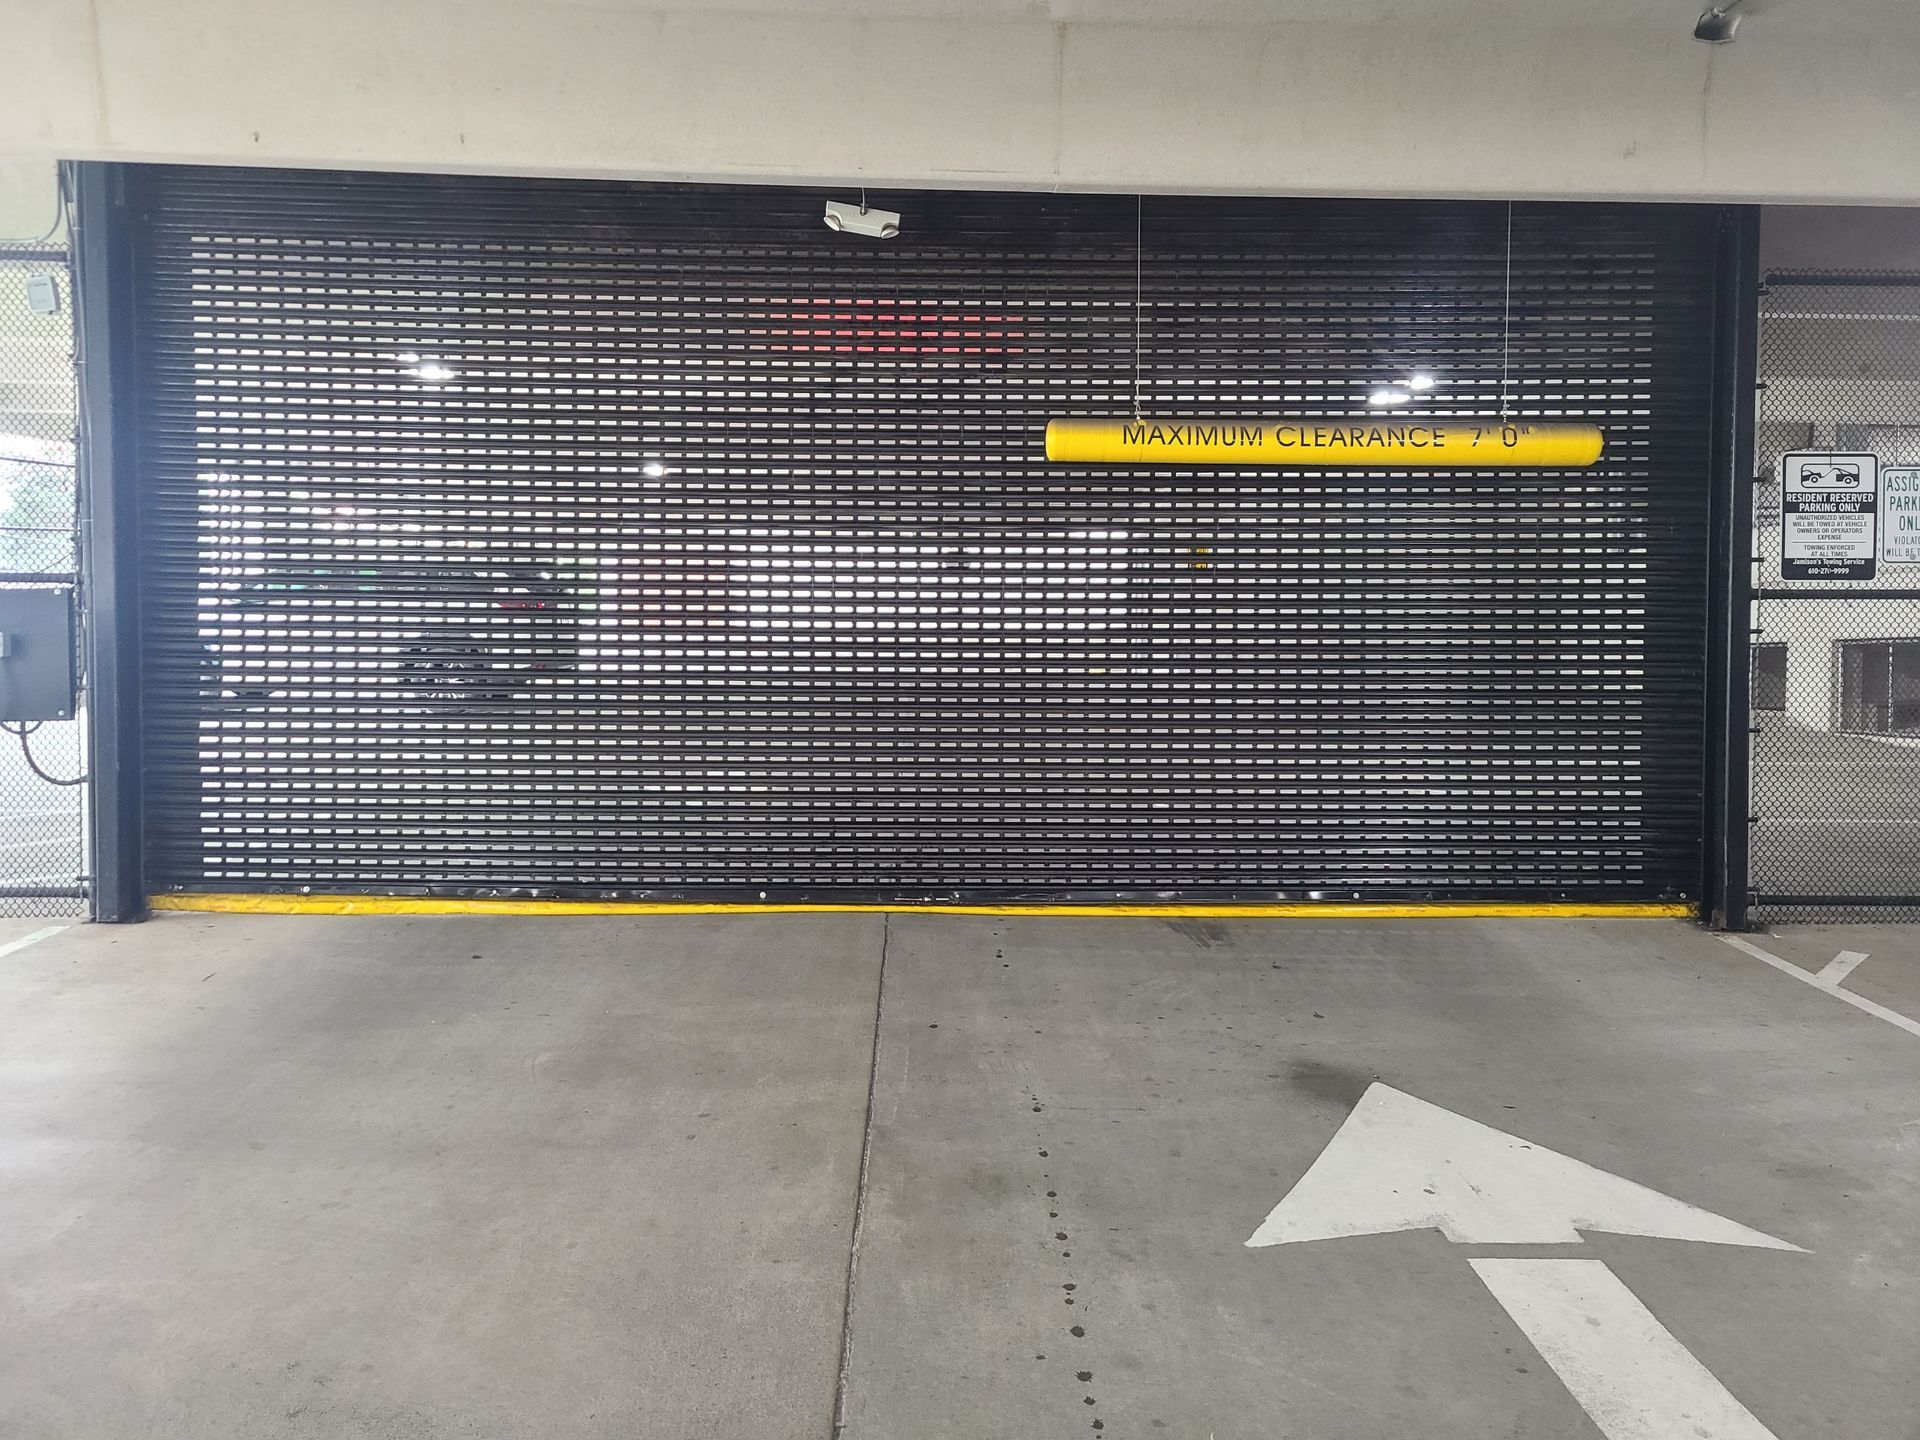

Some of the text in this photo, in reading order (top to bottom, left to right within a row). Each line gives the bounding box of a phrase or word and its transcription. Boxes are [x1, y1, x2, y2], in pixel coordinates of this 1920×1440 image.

[1123, 424, 1530, 448] MAXIMUM CLEARANCE 7' 0"
[1886, 475, 1920, 492] ASSIG
[1786, 493, 1874, 503] RESIDENT RESERVED
[1799, 502, 1861, 512] PARKING ONLY
[1889, 496, 1920, 511] PARKI
[1899, 515, 1920, 531] ONL
[1894, 536, 1920, 545] VIOLATO
[1886, 547, 1903, 557] WILL
[1823, 558, 1843, 566] Towing
